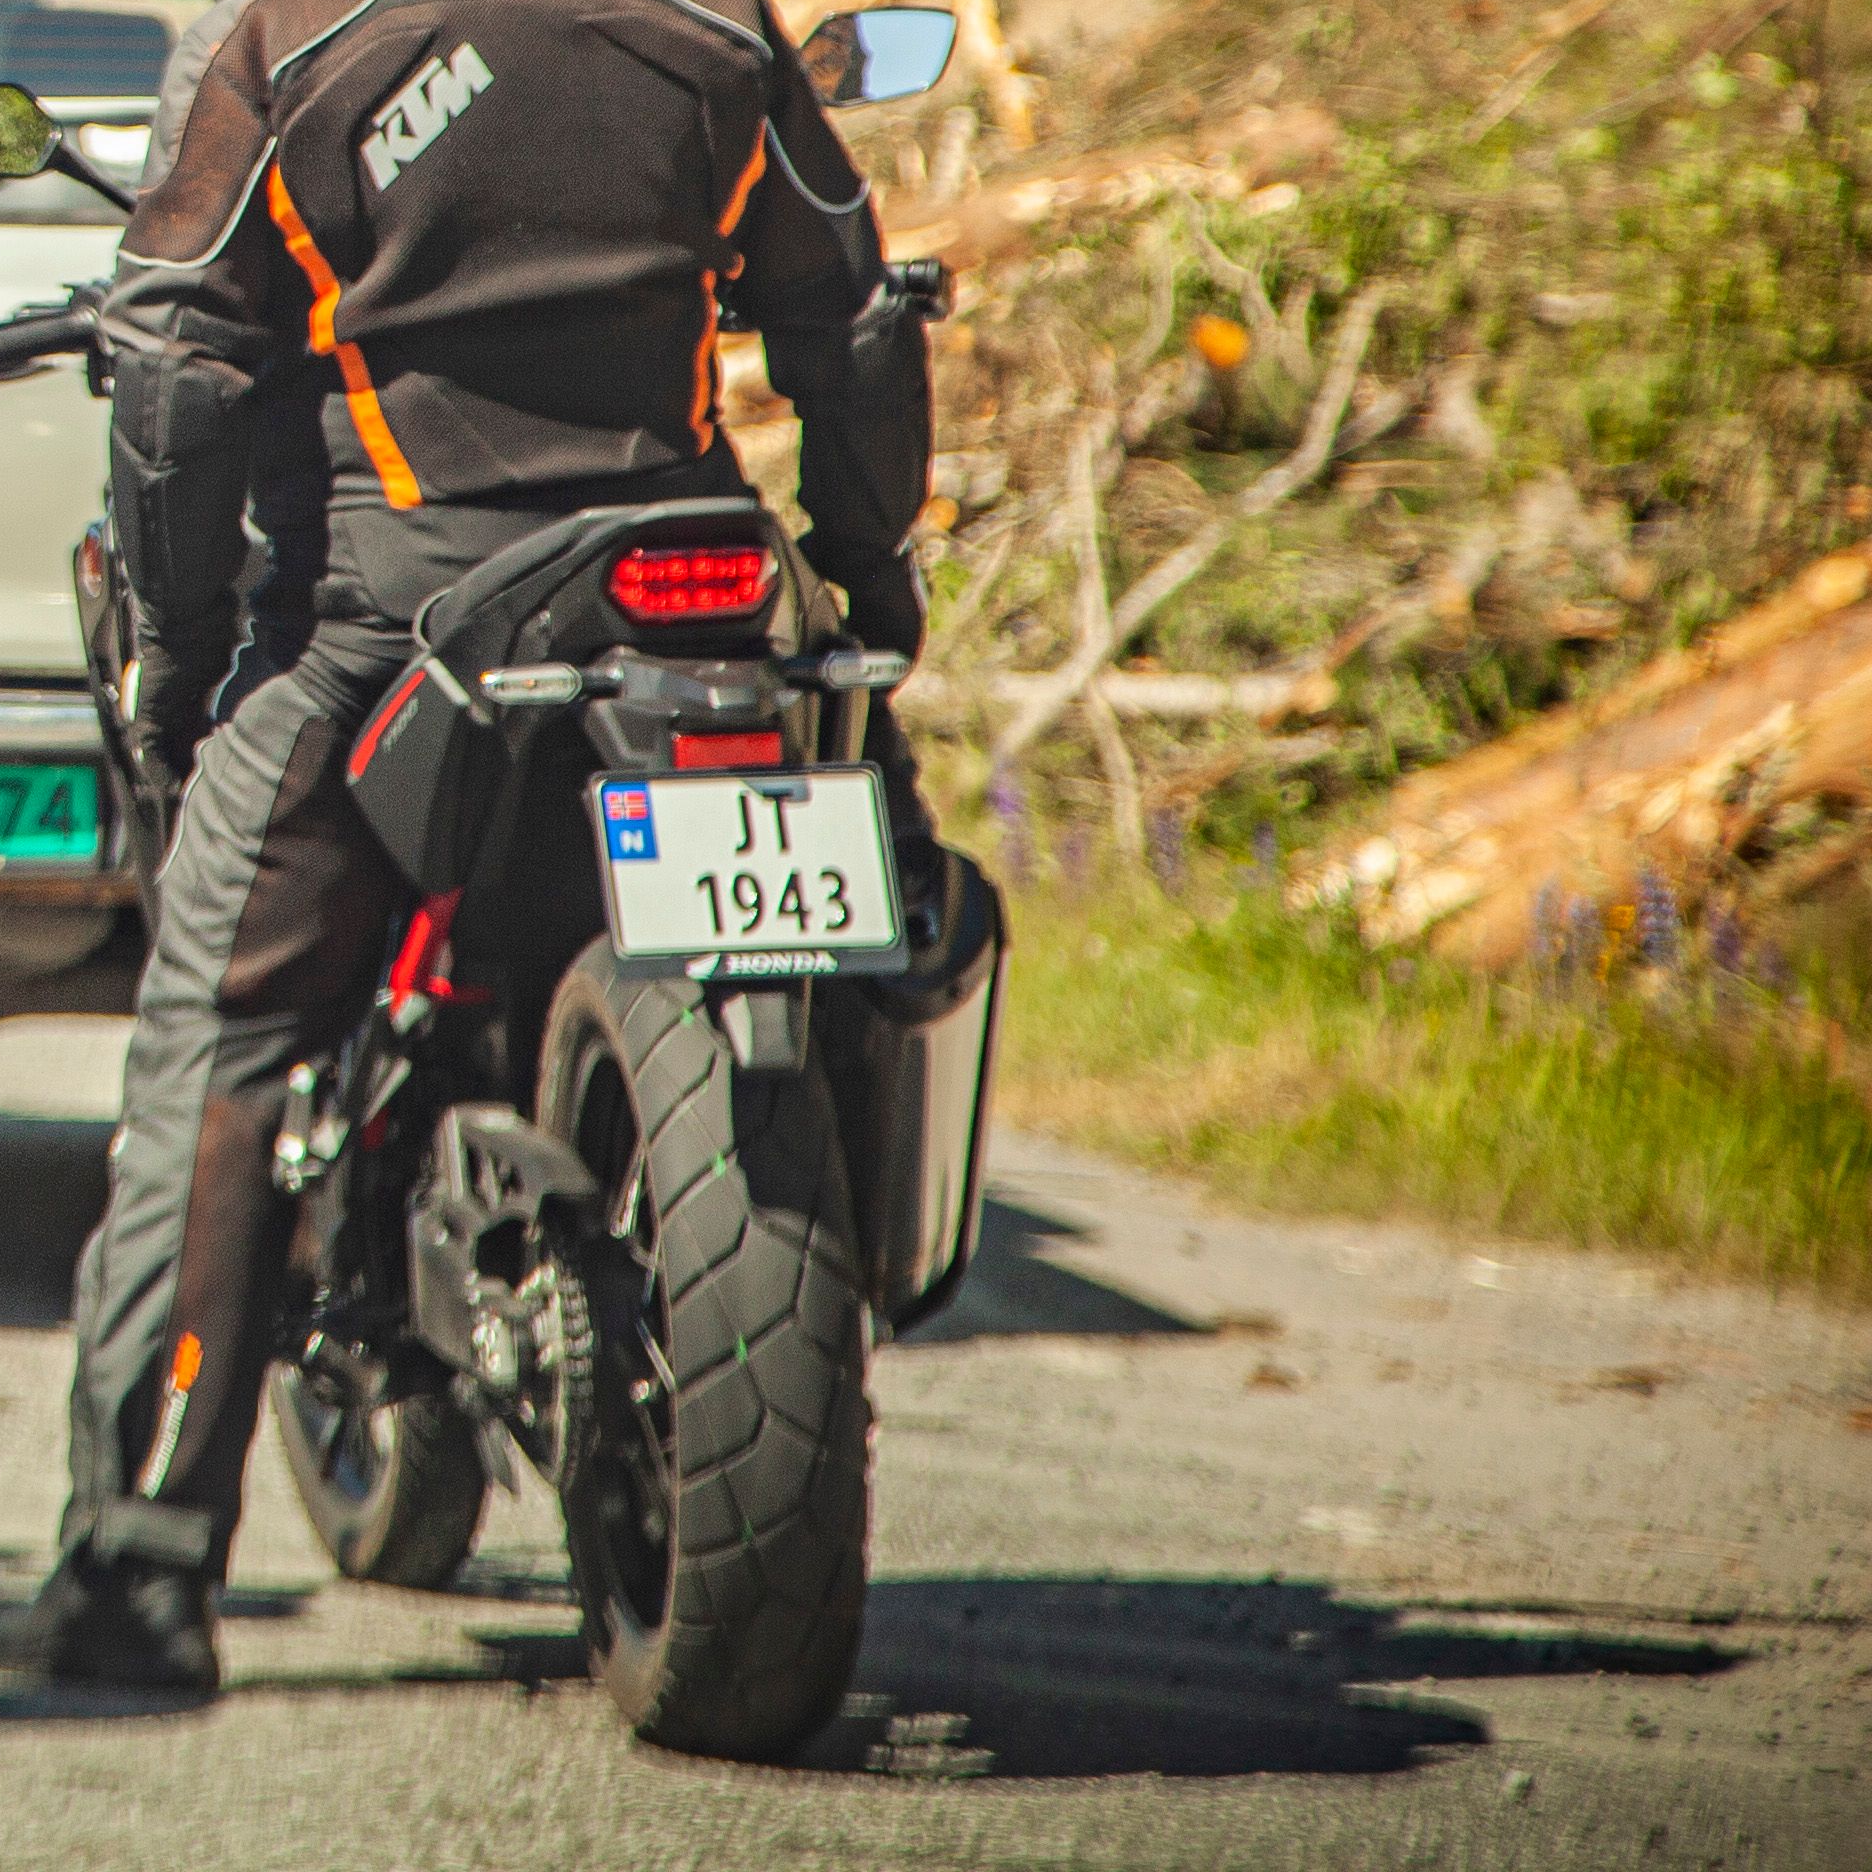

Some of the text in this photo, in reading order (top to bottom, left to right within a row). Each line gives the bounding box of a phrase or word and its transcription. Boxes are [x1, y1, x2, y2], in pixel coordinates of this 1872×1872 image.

[360, 42, 496, 191] KTM
[619, 830, 645, 853] N
[735, 787, 796, 854] JT
[696, 869, 851, 935] 1943
[725, 950, 840, 977] HONDA
